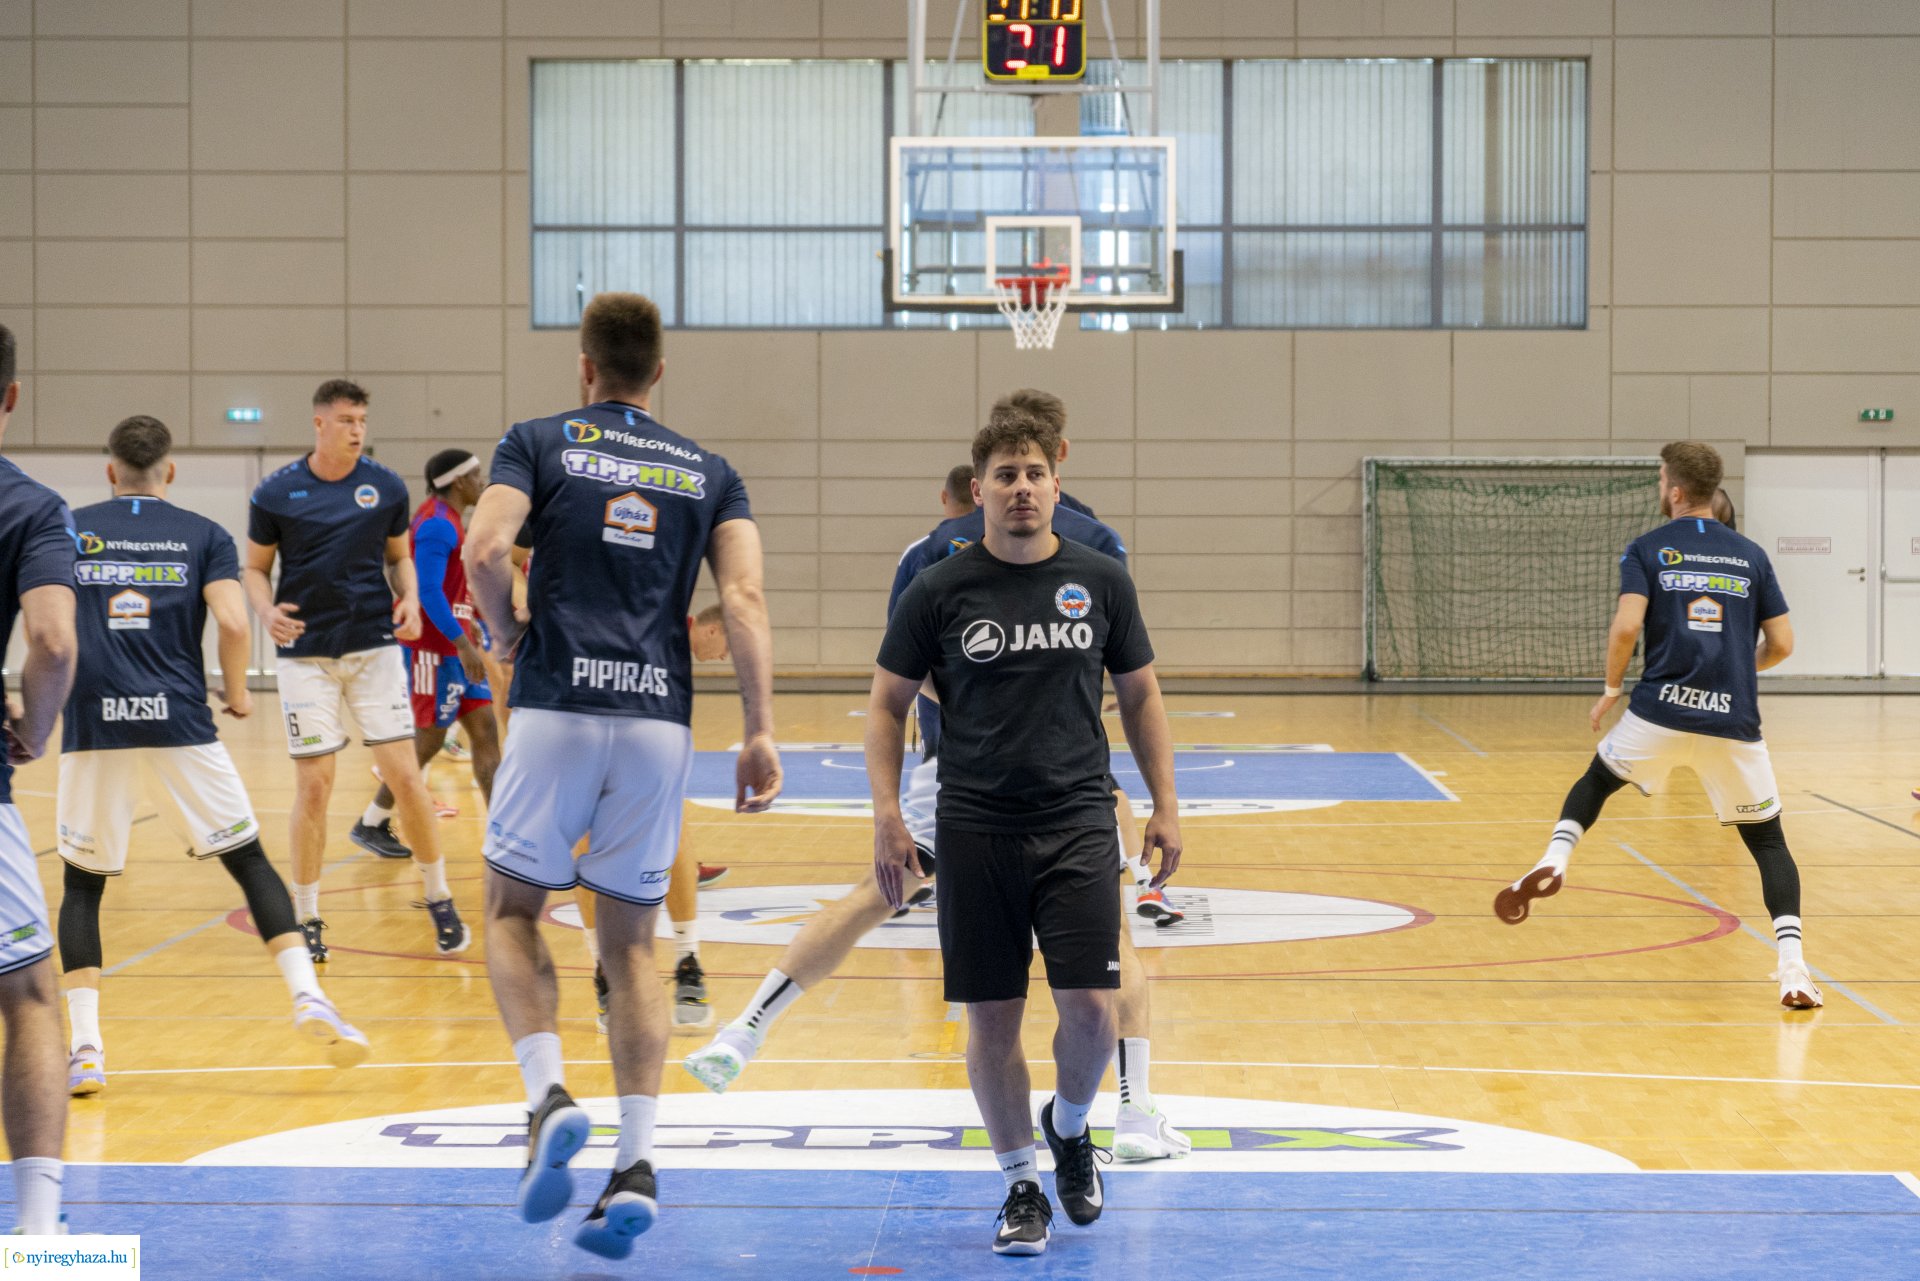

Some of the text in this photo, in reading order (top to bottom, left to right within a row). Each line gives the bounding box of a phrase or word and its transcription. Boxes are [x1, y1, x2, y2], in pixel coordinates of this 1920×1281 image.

[604, 428, 702, 462] NYÍREGYHÁZA
[106, 539, 188, 552] NYÍREGYHÁZA
[1684, 554, 1750, 568] NYÍREGYHÁZA
[1009, 622, 1093, 651] JAKO
[572, 657, 668, 697] PIPIRAS
[102, 692, 168, 722] BAZSÓ
[1658, 683, 1732, 714] FAZEKAS
